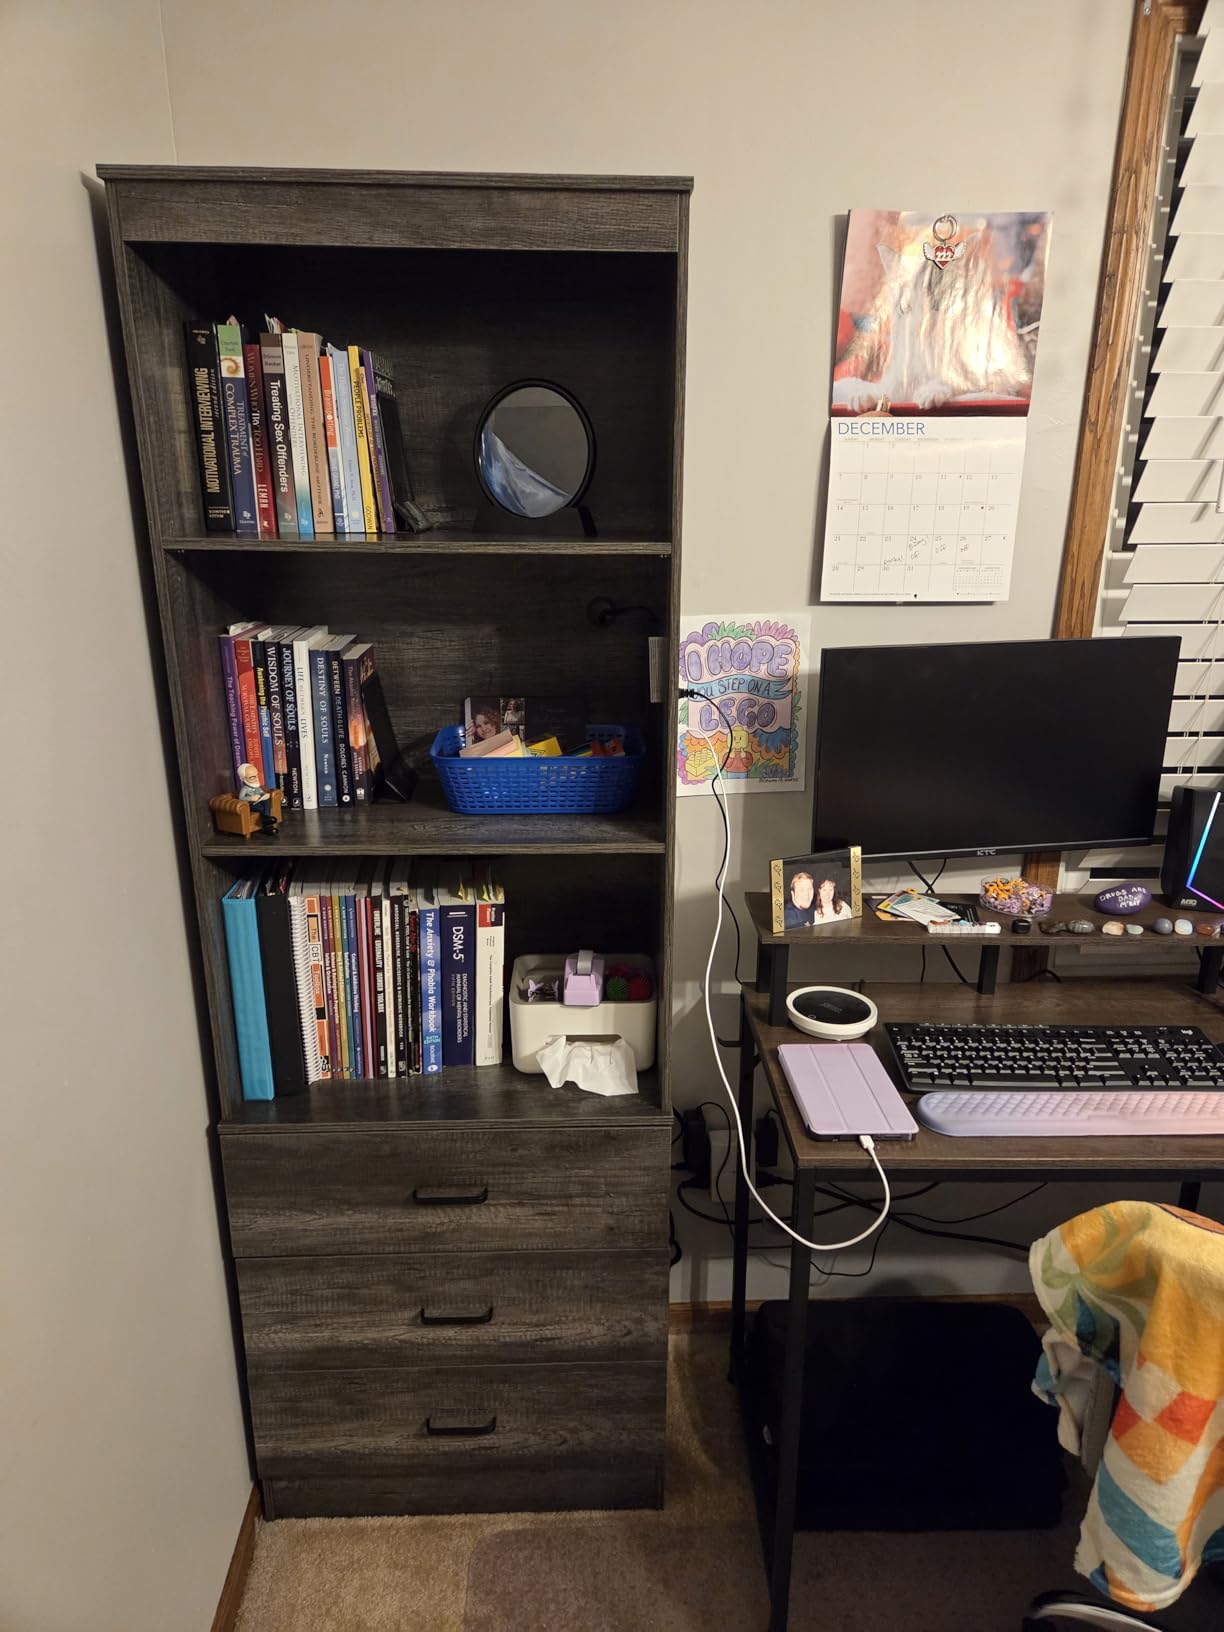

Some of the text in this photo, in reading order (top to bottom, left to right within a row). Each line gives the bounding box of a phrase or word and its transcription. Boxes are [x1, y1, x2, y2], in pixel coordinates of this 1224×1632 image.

[248, 352, 257, 387] WOMEN
[305, 354, 314, 415] UNDERSTANDING
[195, 367, 213, 430] INTERVIEWING
[271, 380, 284, 421] Treating
[353, 381, 364, 438] PEOPLE PROBLEMS
[225, 384, 242, 475] COMPLEX TRAUMA
[236, 401, 250, 449] TREATMENT
[252, 410, 261, 427] TRY
[275, 424, 286, 442] Sex
[292, 365, 306, 476] MOTIVATIONAL INTERVIEWING
[838, 422, 925, 435] DECEMBER
[202, 431, 221, 493] MOTIVATIONAL
[255, 447, 264, 473] HARD
[277, 443, 289, 493] Offenders
[365, 505, 374, 530] GODWIN
[331, 660, 341, 695] BETWEEN
[687, 641, 792, 681] I HOPE
[228, 689, 236, 717] Teaching
[257, 667, 265, 697] Awakening
[261, 705, 269, 726] Psychic
[267, 647, 283, 746] WISDOM OF SOULS
[283, 648, 296, 731] JOURNEY OF SOULS
[317, 657, 329, 744] DESTINY OF SOULS
[717, 677, 745, 694] STEP
[747, 677, 761, 695] ON
[762, 682, 771, 697] A
[335, 696, 343, 719] DEATH
[700, 697, 776, 731] LEGO
[300, 718, 308, 738] LIVES
[337, 725, 345, 739] LIFE
[339, 743, 347, 769] DOLORES
[291, 767, 299, 794] NEWTON
[1100, 886, 1147, 901] DRUGS ARE
[311, 945, 320, 962] CBT
[313, 971, 321, 994] Toolbox
[425, 912, 437, 1033] The Anxiety & Phobia Workbook
[377, 993, 385, 1013] TOOLBOX
